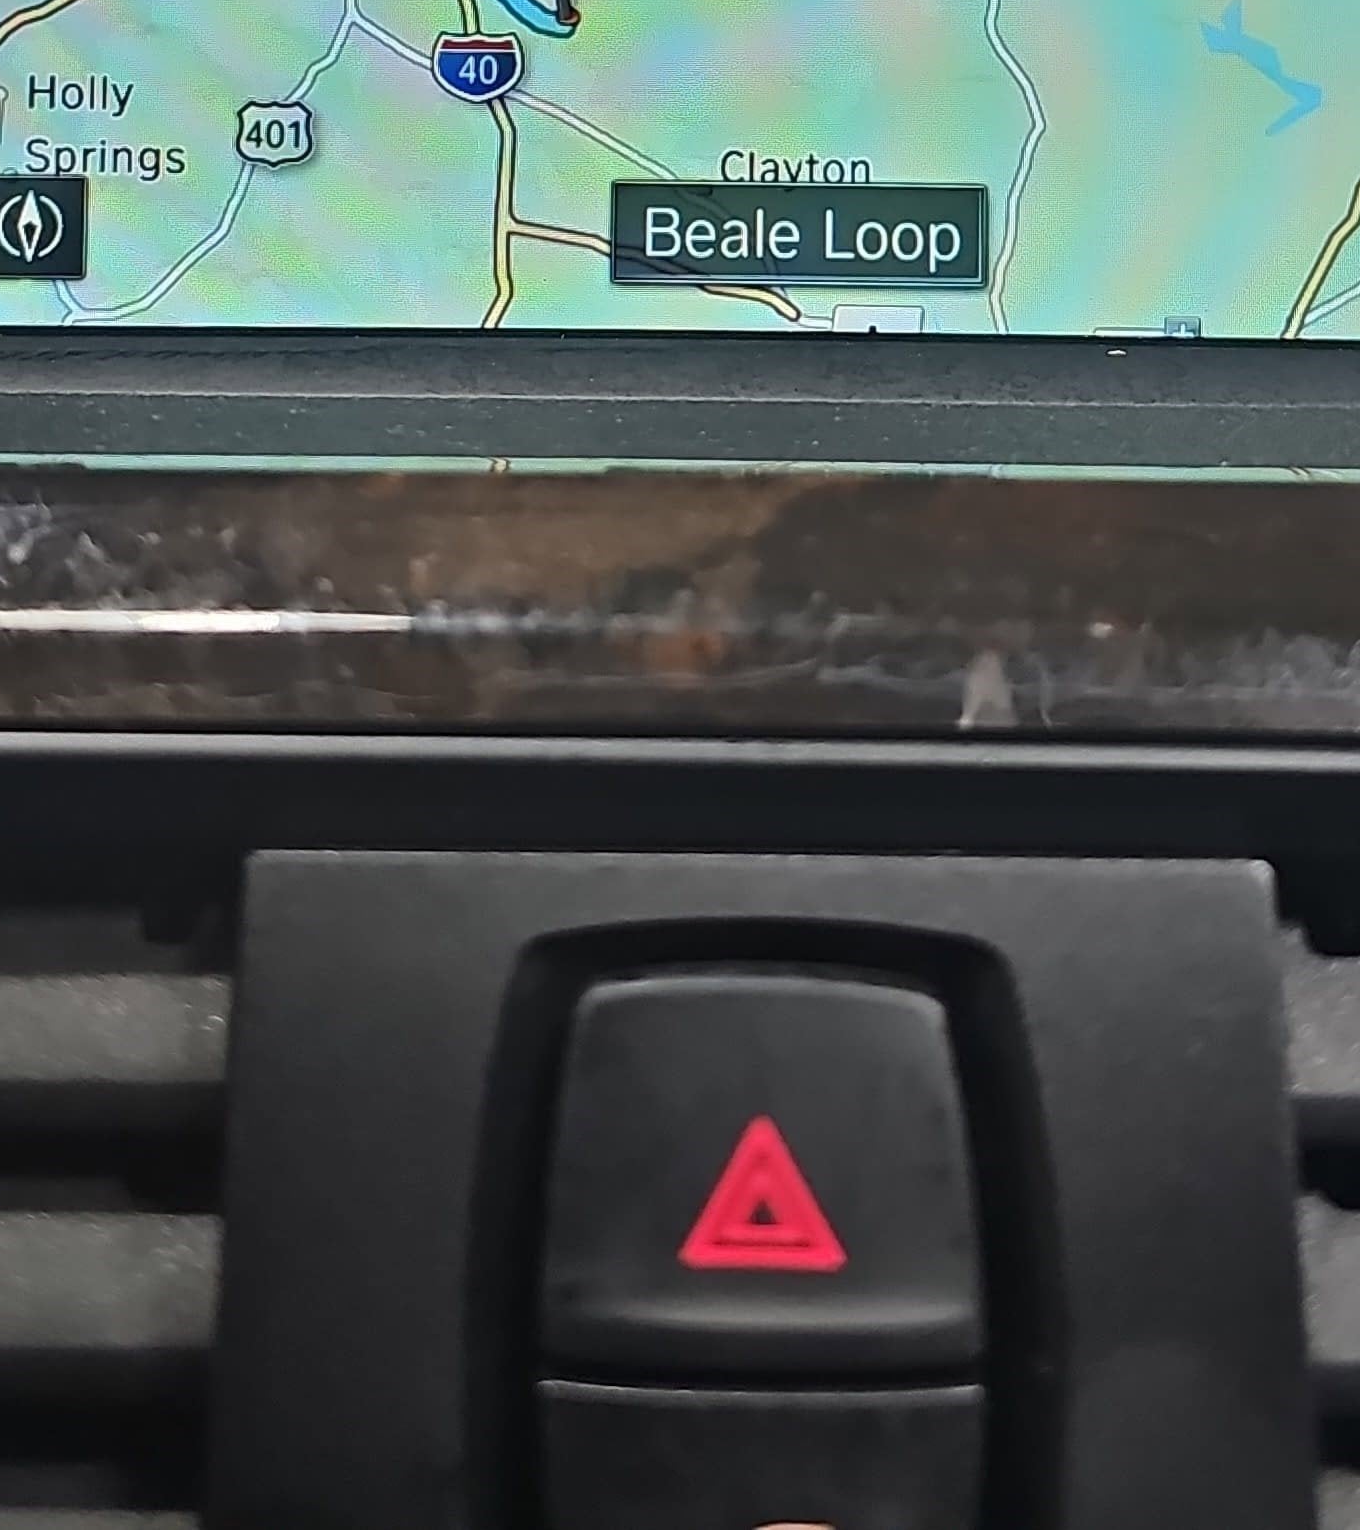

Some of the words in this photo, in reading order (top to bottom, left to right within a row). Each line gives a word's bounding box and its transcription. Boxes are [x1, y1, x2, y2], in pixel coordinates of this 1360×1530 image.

[459, 56, 497, 83] 40
[29, 74, 133, 115] Holly
[246, 120, 302, 149] 401
[26, 138, 186, 180] Springs
[720, 150, 871, 183] Clayton
[646, 207, 799, 258] Beale
[825, 209, 961, 273] Loop
